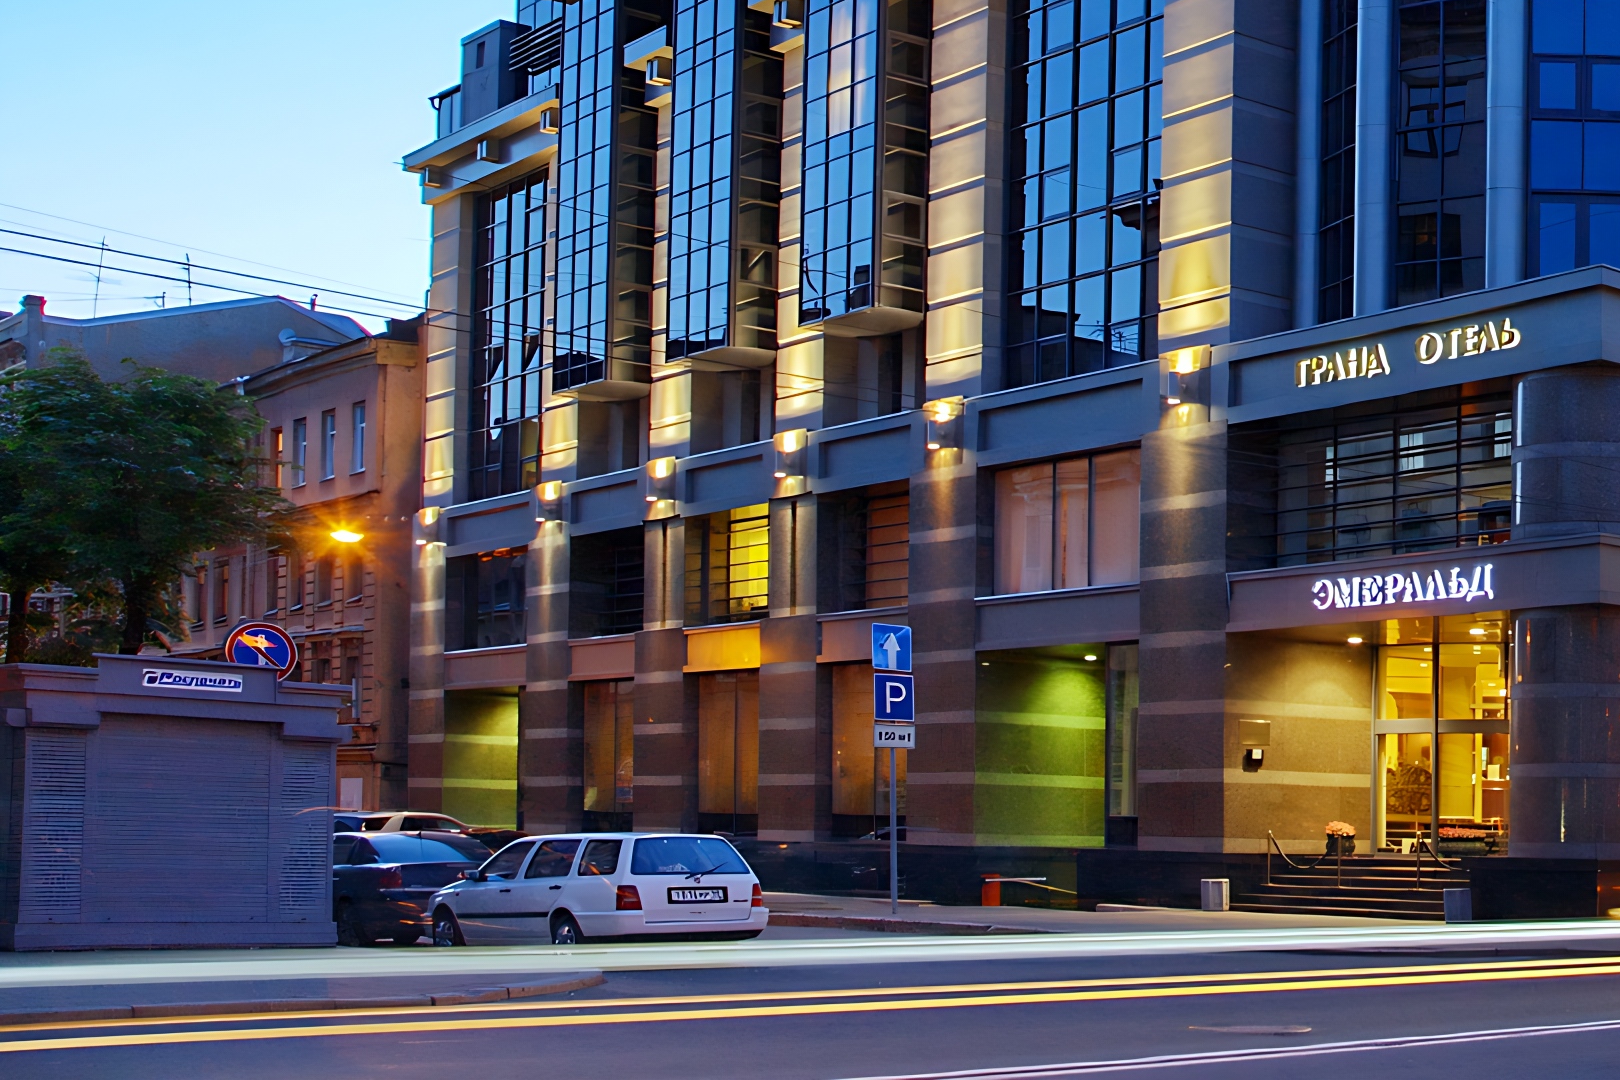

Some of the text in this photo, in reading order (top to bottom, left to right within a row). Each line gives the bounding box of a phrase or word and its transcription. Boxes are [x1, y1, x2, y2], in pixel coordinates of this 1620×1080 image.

[1296, 318, 1522, 387] ГРАНД ОТЕЛЬ
[1312, 563, 1495, 610] ЭМЕРАЛЬД
[885, 681, 906, 714] P
